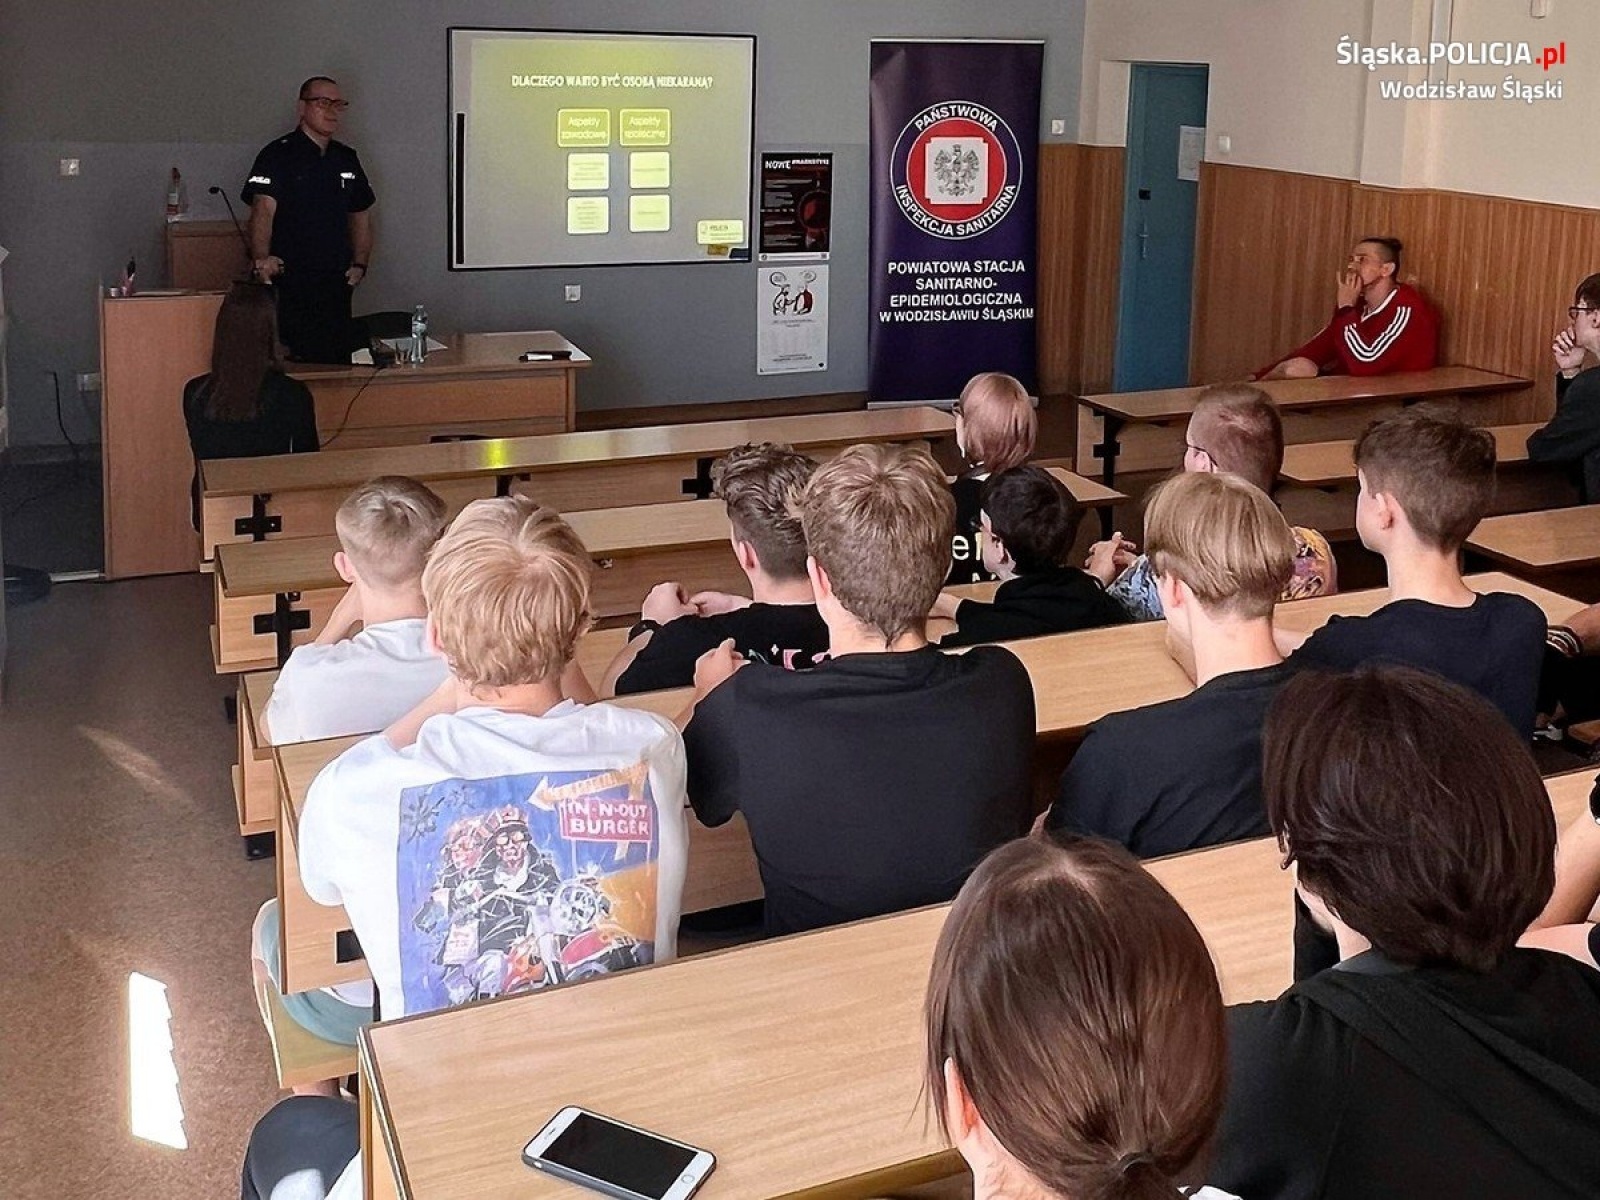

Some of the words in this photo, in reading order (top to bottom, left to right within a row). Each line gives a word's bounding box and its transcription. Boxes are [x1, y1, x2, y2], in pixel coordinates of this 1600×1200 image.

[511, 75, 564, 87] DLACZEGO
[566, 75, 599, 87] WARTO
[601, 73, 621, 87] BYĆ
[622, 75, 655, 89] OSOBĄ
[568, 116, 601, 128] Aspekty
[629, 115, 661, 128] Aspekty
[914, 104, 999, 133] PAŃSTWOWA
[765, 160, 791, 170] NOWE
[896, 184, 954, 236] INSPEKCJA
[955, 184, 1017, 236] SANITARNA
[888, 262, 971, 275] POWIATOWA
[974, 260, 1025, 273] STACJA
[915, 277, 998, 291] SANITARNO-
[890, 293, 1023, 307] EPIDEMIOLOGICZNA
[879, 311, 893, 322] W
[894, 309, 979, 322] WODZISŁAWIU
[569, 818, 649, 836] BURGER
